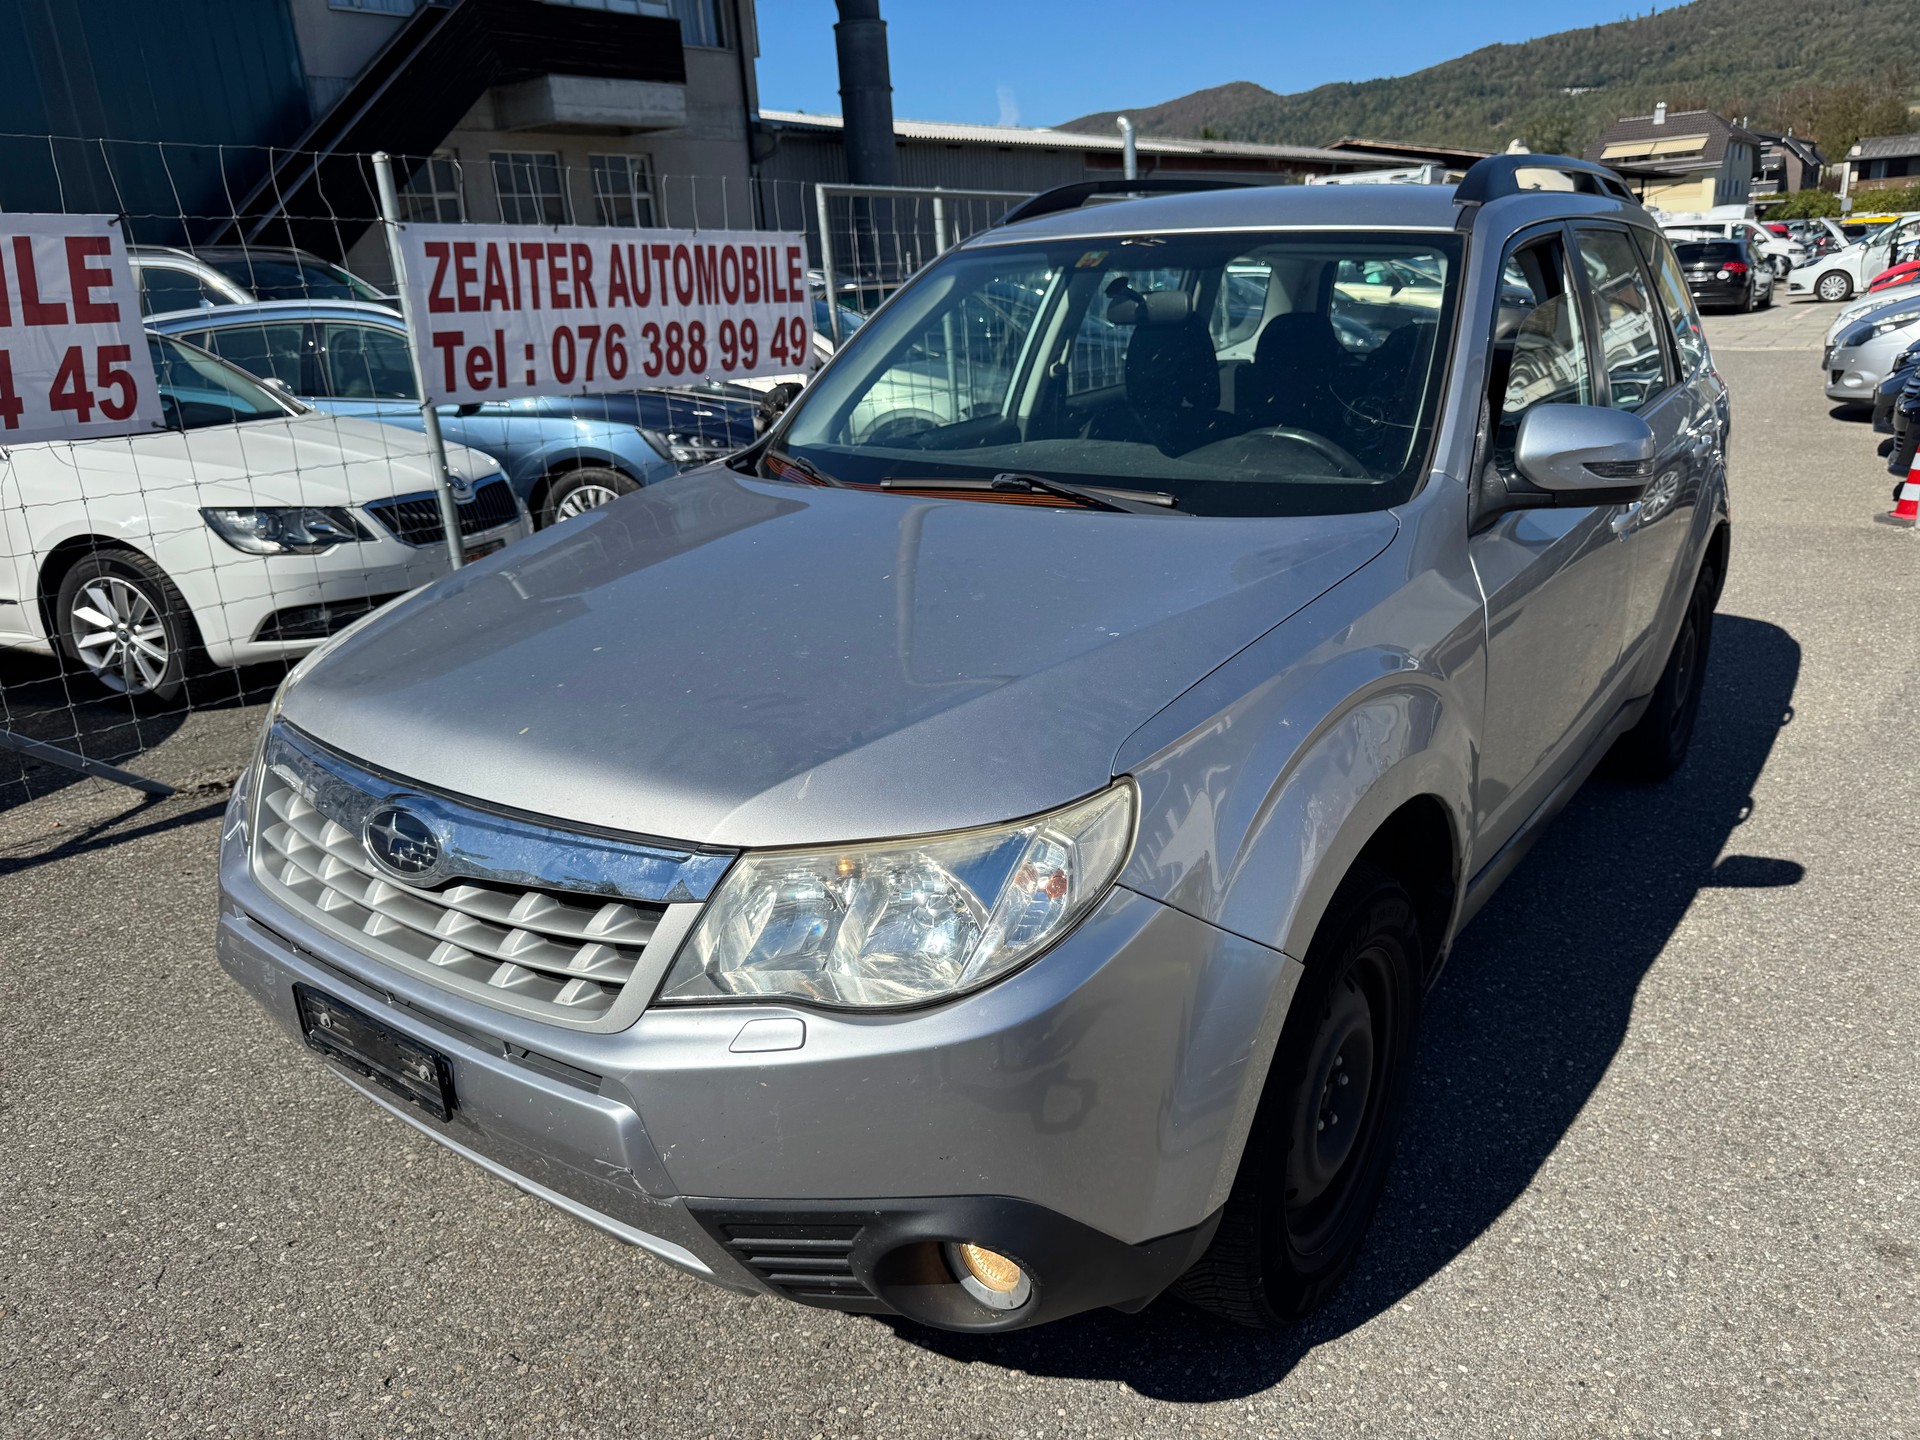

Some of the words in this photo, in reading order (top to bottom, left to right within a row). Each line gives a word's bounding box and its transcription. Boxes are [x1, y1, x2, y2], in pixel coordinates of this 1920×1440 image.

[424, 241, 598, 313] ZEAITER
[608, 243, 804, 308] AUTOMOBILE
[49, 344, 138, 423] 45
[433, 329, 507, 393] Tel
[552, 323, 628, 384] 076
[642, 320, 708, 378] 388
[719, 318, 758, 372] 99
[770, 316, 806, 367] 49
